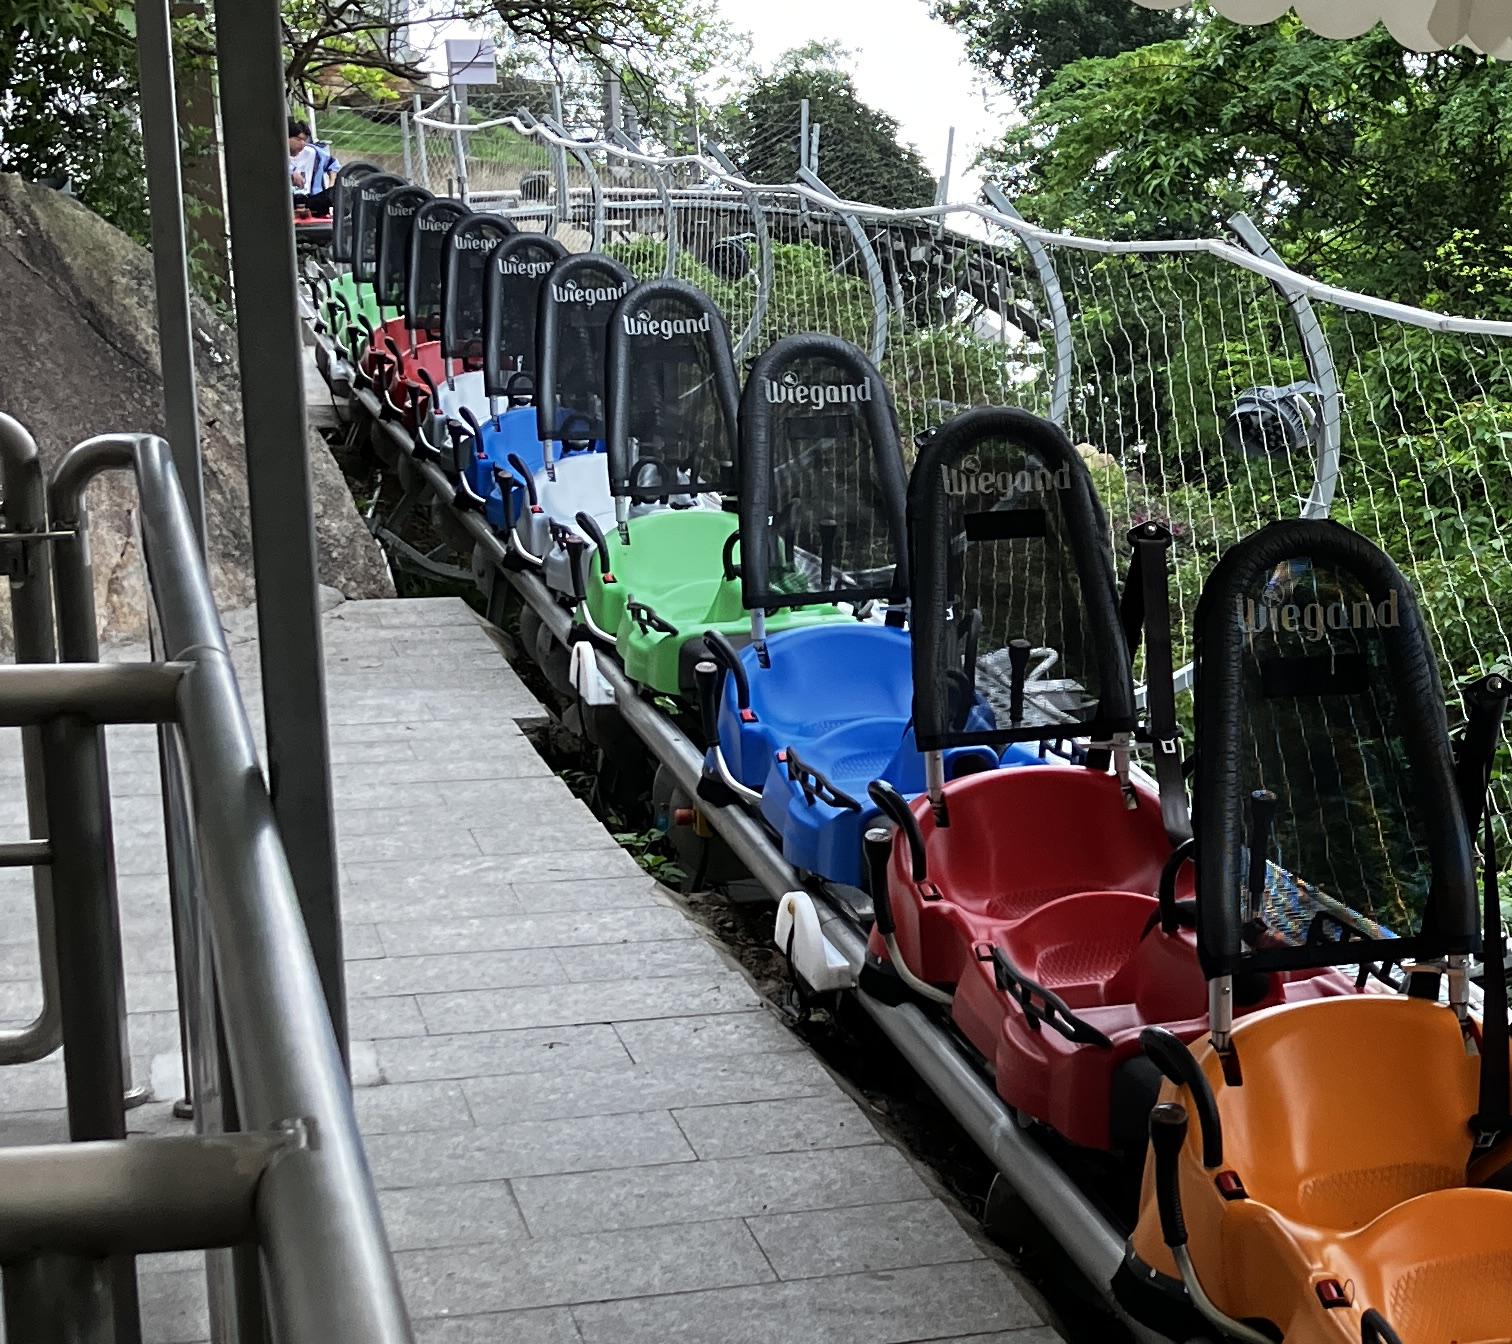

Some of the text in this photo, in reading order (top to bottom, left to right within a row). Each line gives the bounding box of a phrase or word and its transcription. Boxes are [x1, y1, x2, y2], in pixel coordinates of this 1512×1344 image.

[552, 279, 628, 306] Wiegand
[623, 309, 711, 340] Wiegand
[764, 370, 872, 410] Wiegand
[940, 455, 1071, 501] Wiegand
[1235, 583, 1401, 642] Wiegand
